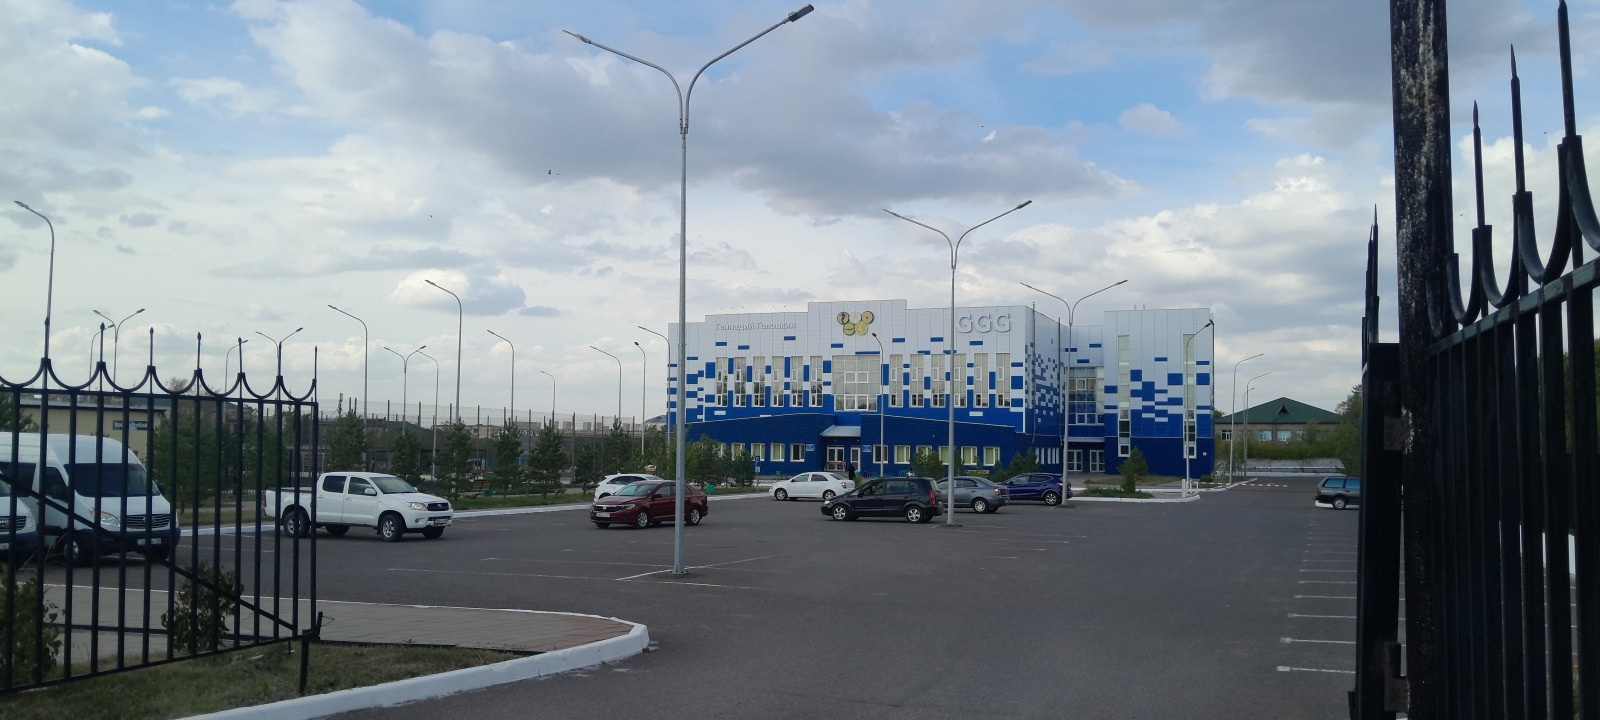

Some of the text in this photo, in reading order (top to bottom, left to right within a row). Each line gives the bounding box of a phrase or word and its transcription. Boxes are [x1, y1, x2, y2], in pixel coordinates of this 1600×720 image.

[716, 322, 797, 331] Геннадий Головкин
[956, 313, 1011, 333] GGG
